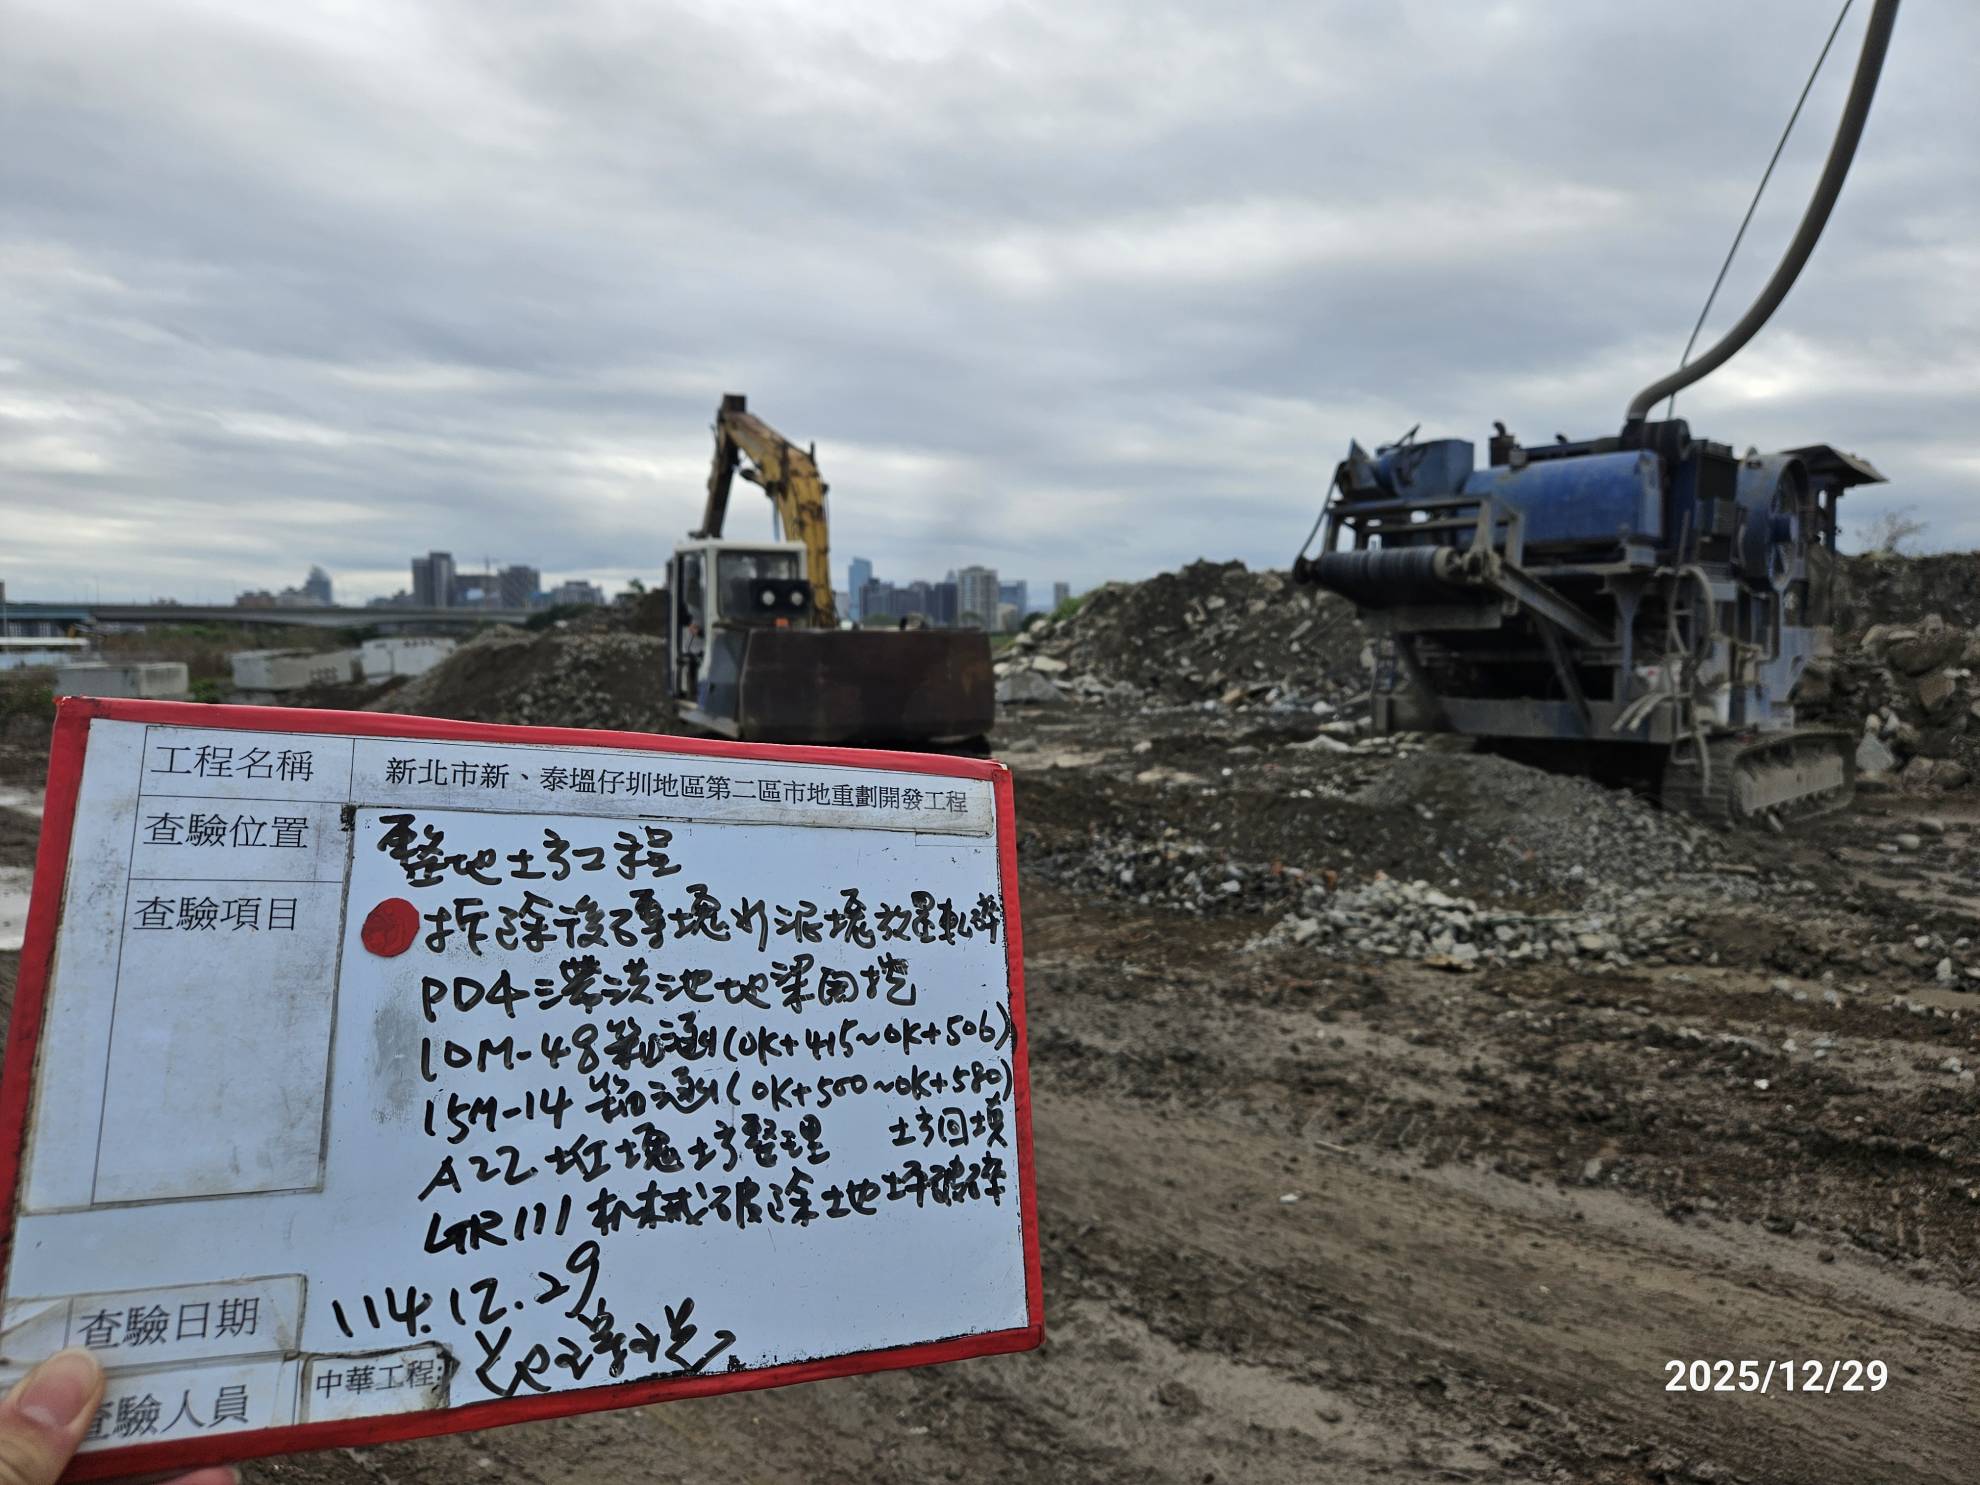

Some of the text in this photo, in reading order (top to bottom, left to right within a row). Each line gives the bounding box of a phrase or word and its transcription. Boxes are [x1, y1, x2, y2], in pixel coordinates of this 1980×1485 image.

[150, 745, 314, 783] 工程名稱
[385, 756, 969, 814] 新北市新、泰塭仔圳地區第二區市地重劃開發工程
[143, 812, 309, 850] 查驗位置
[133, 896, 299, 932] 查驗項目
[78, 1297, 261, 1350] 查驗日期
[316, 1358, 437, 1399] 中華工程
